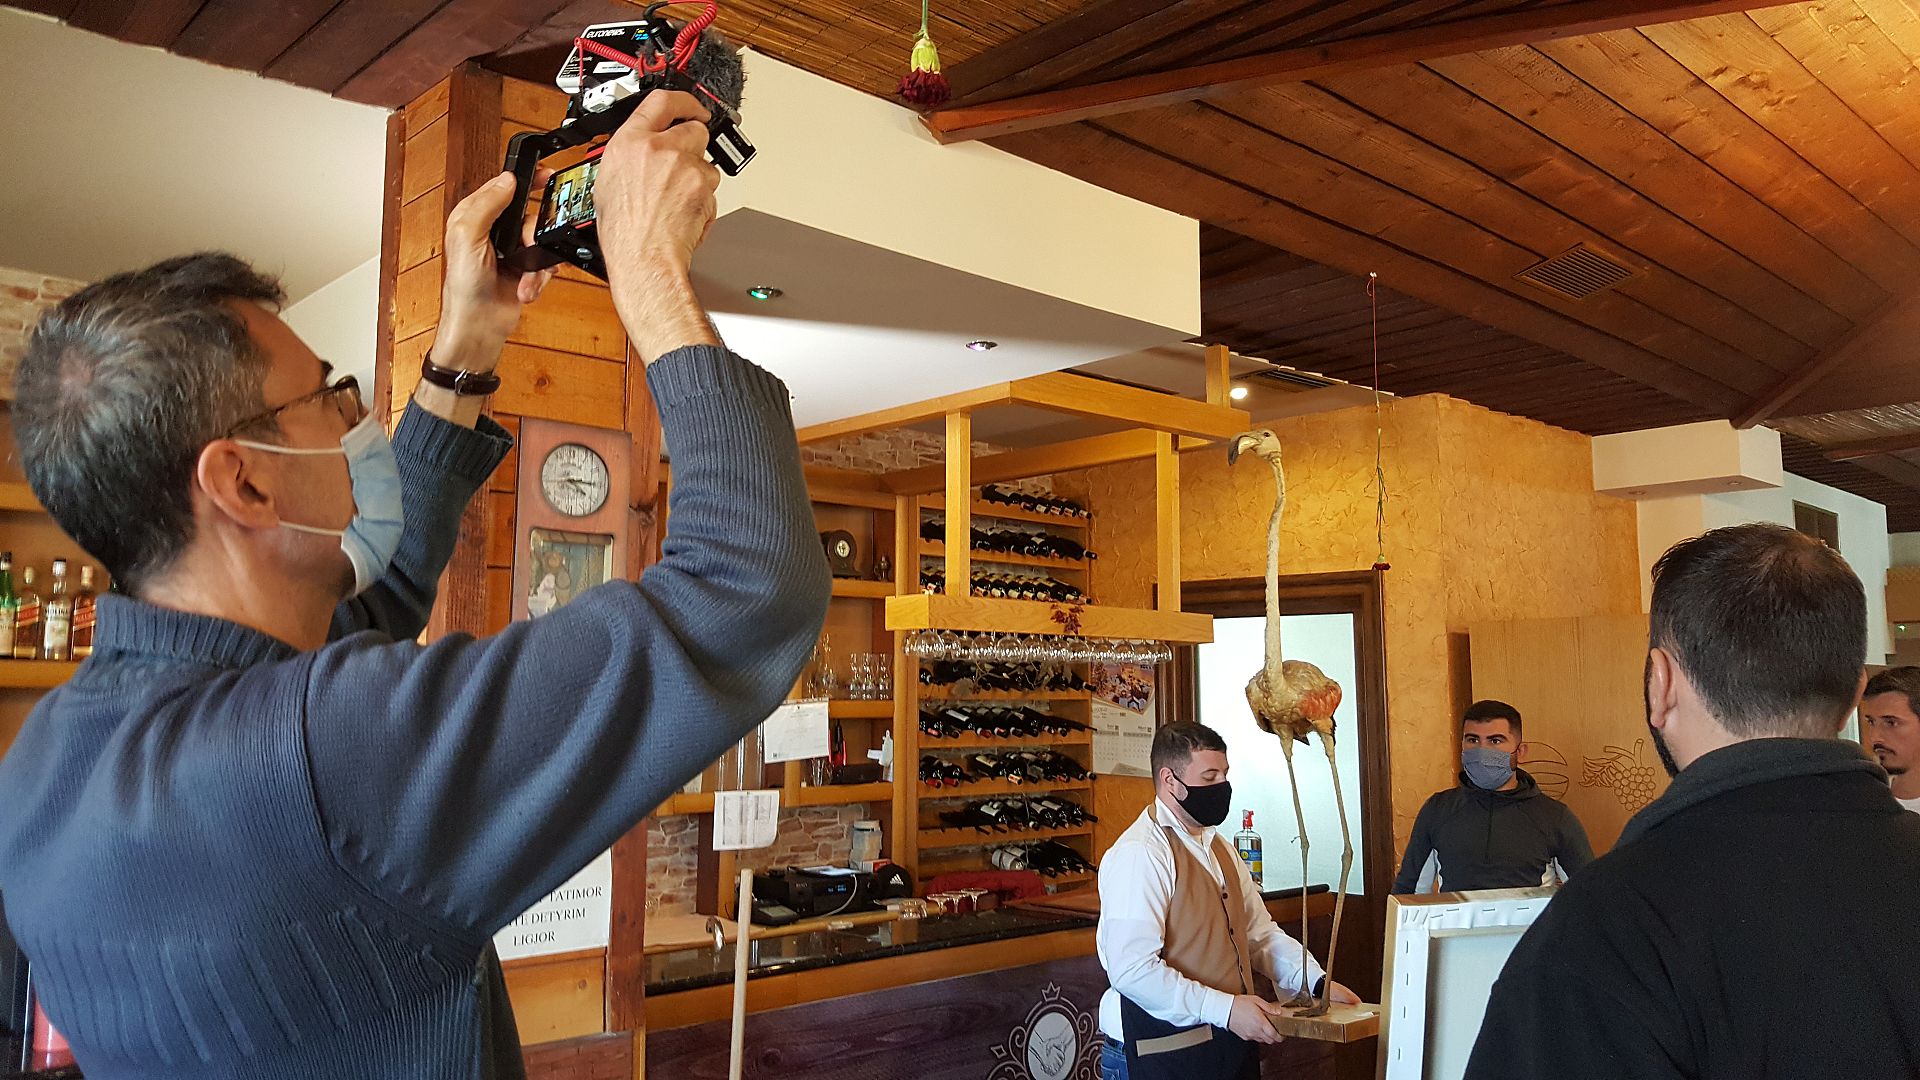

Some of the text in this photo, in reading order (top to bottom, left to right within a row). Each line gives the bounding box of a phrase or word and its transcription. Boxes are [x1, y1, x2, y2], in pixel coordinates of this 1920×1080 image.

[549, 886, 602, 902] TATIMOR
[531, 907, 586, 924] DETYRIM
[513, 931, 556, 947] LIGJOR
